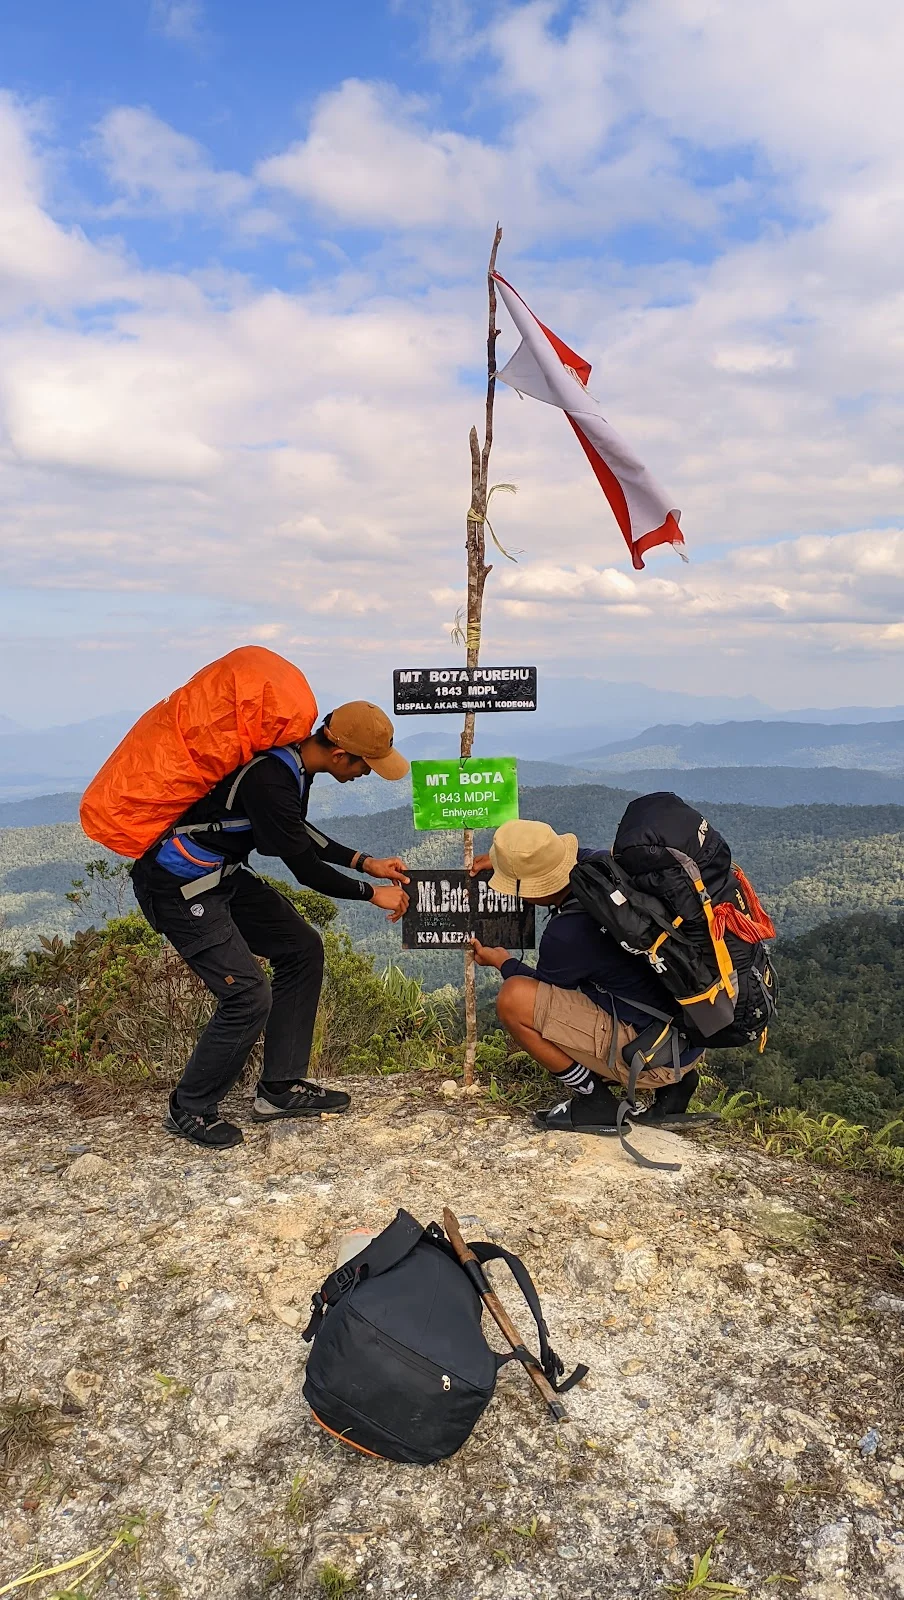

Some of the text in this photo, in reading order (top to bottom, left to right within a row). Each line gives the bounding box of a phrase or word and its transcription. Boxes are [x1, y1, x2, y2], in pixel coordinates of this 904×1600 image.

[399, 669, 530, 683] MT BOTA PUREHU
[435, 685, 498, 697] 1843 MDPL
[396, 703, 432, 711] SISPALA
[434, 702, 458, 710] AKAR
[461, 701, 486, 709] SMAN
[495, 700, 535, 708] KODEOHA
[426, 771, 505, 786] MT BOTA
[433, 792, 461, 803] 1843
[464, 791, 500, 803] MDPL
[442, 807, 489, 818] Enhiyen21
[417, 931, 441, 944] KPA
